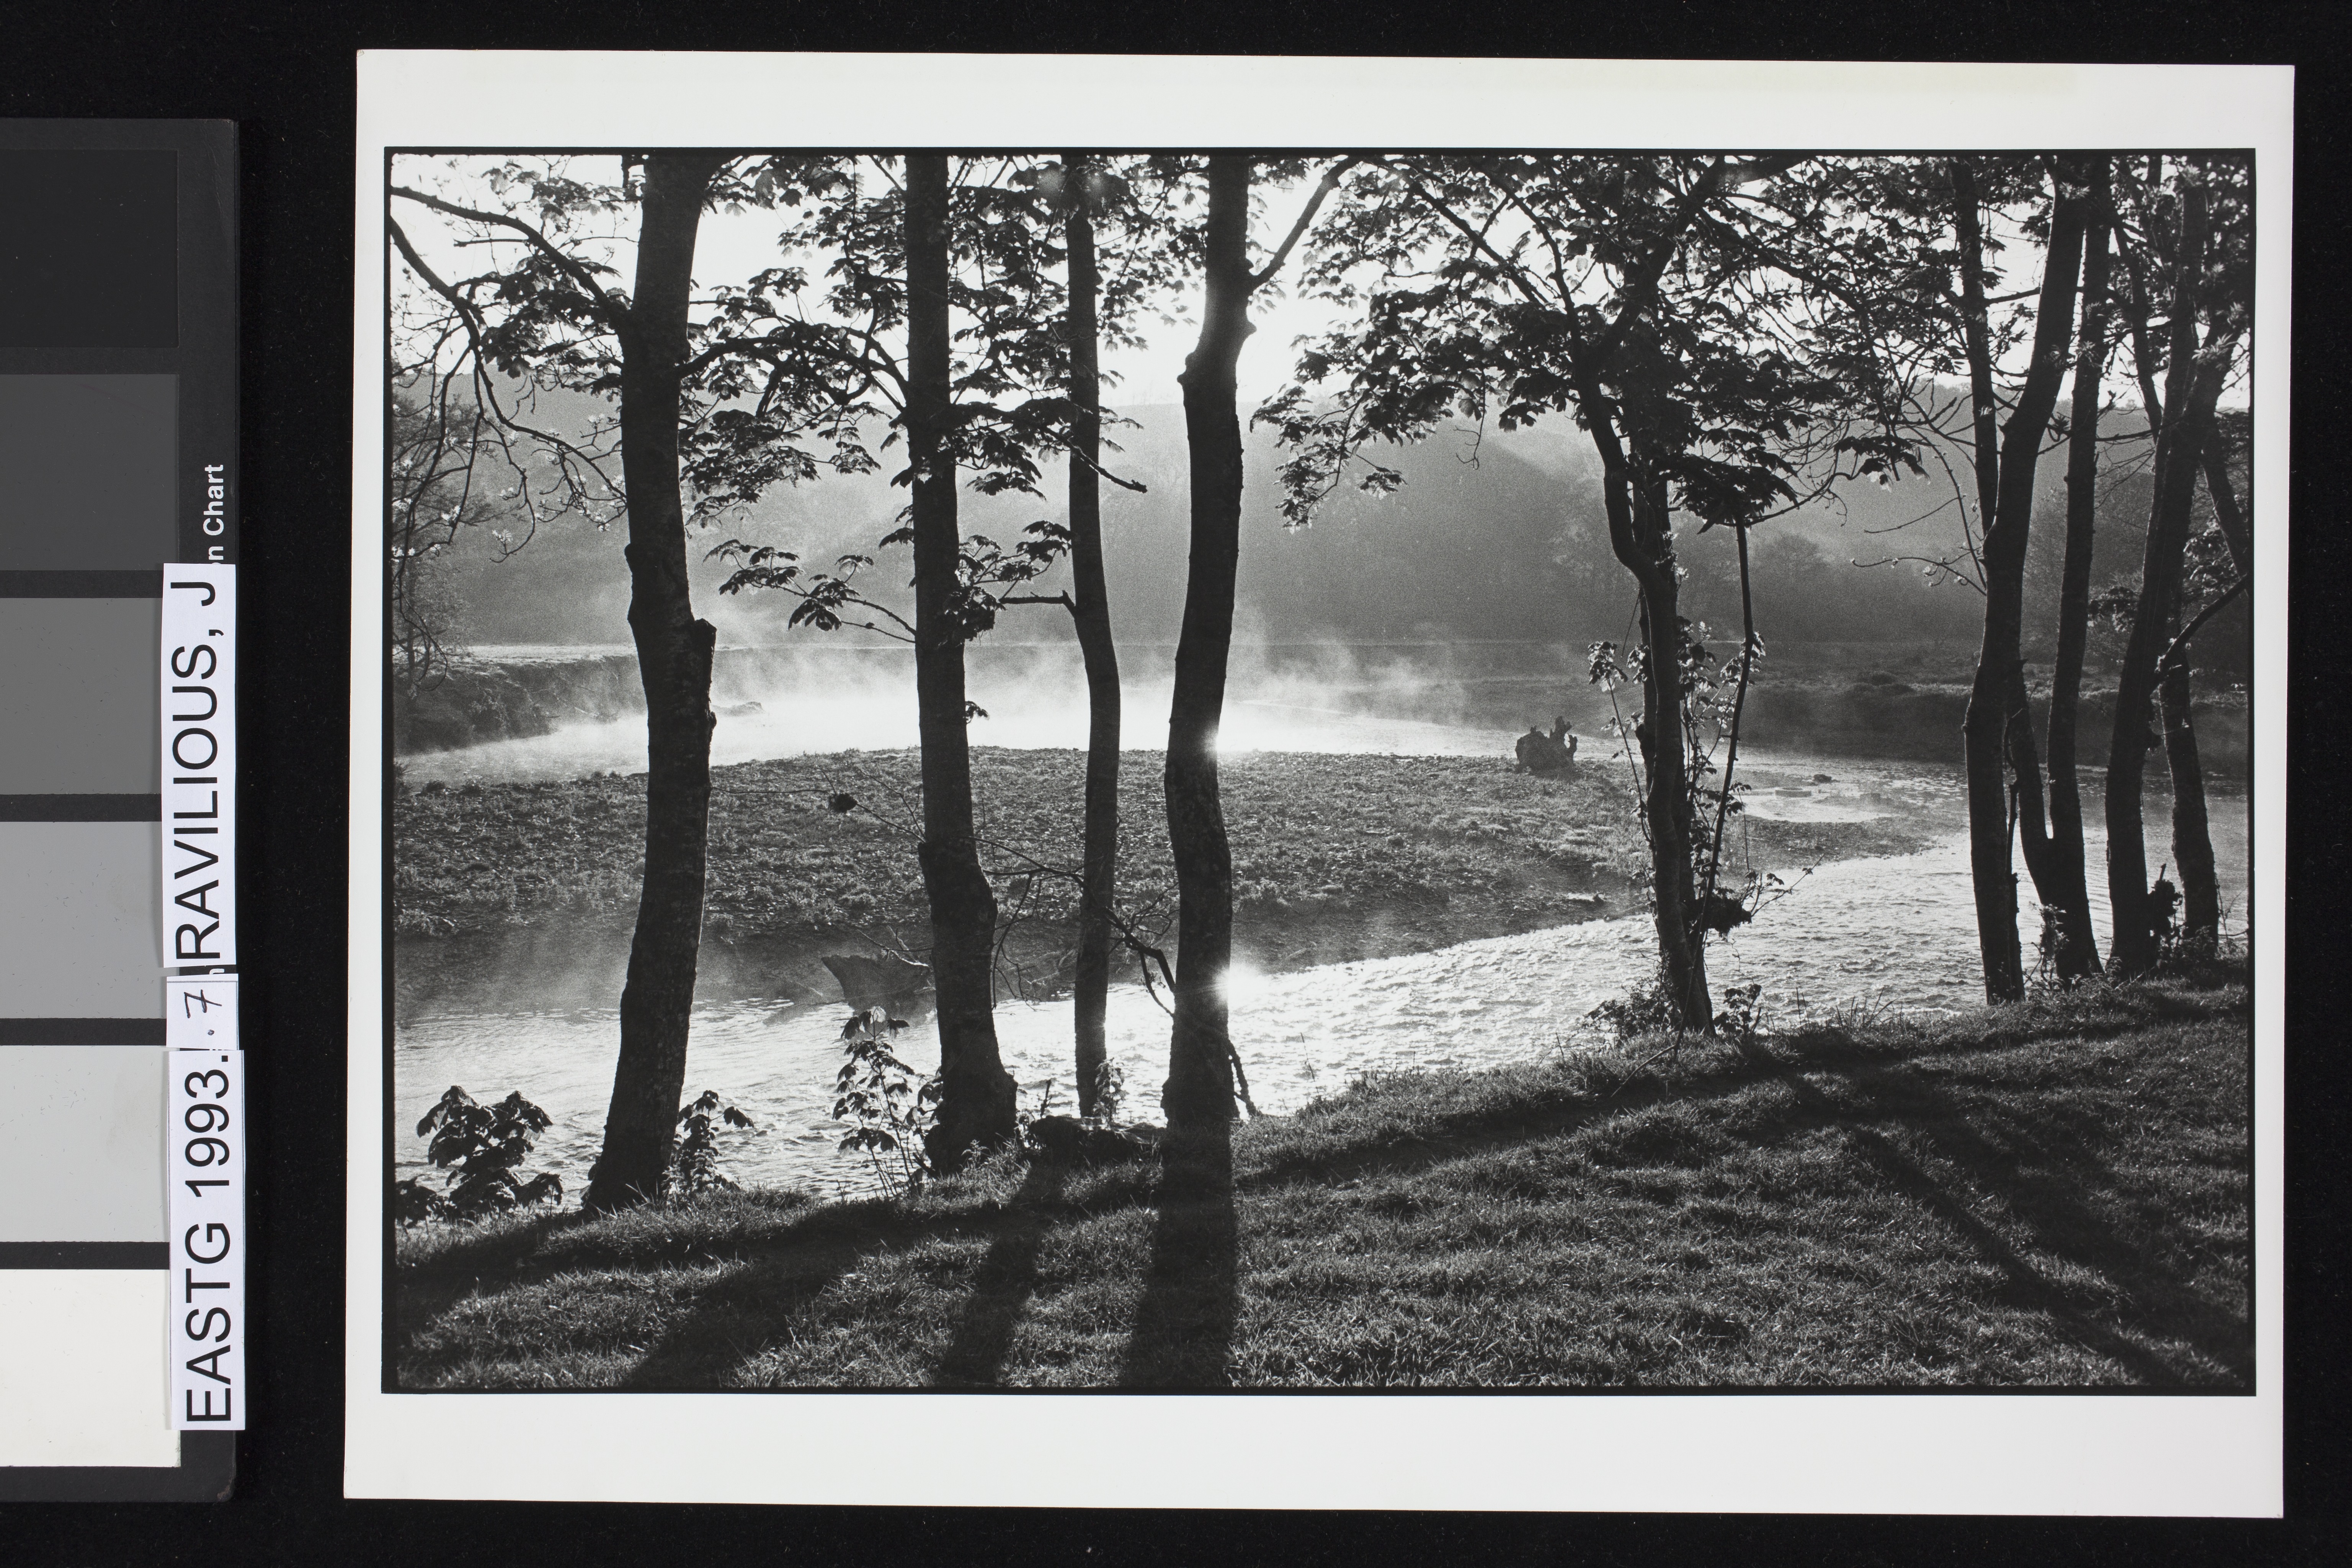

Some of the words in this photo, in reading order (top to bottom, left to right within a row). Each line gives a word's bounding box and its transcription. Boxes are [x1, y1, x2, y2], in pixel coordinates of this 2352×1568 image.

[203, 464, 224, 536] Chart
[170, 582, 216, 606] J
[209, 546, 224, 564] n
[171, 629, 224, 959] RAVILIOUS,
[185, 1055, 230, 1197] 1993.
[185, 1223, 231, 1422] EASTG
